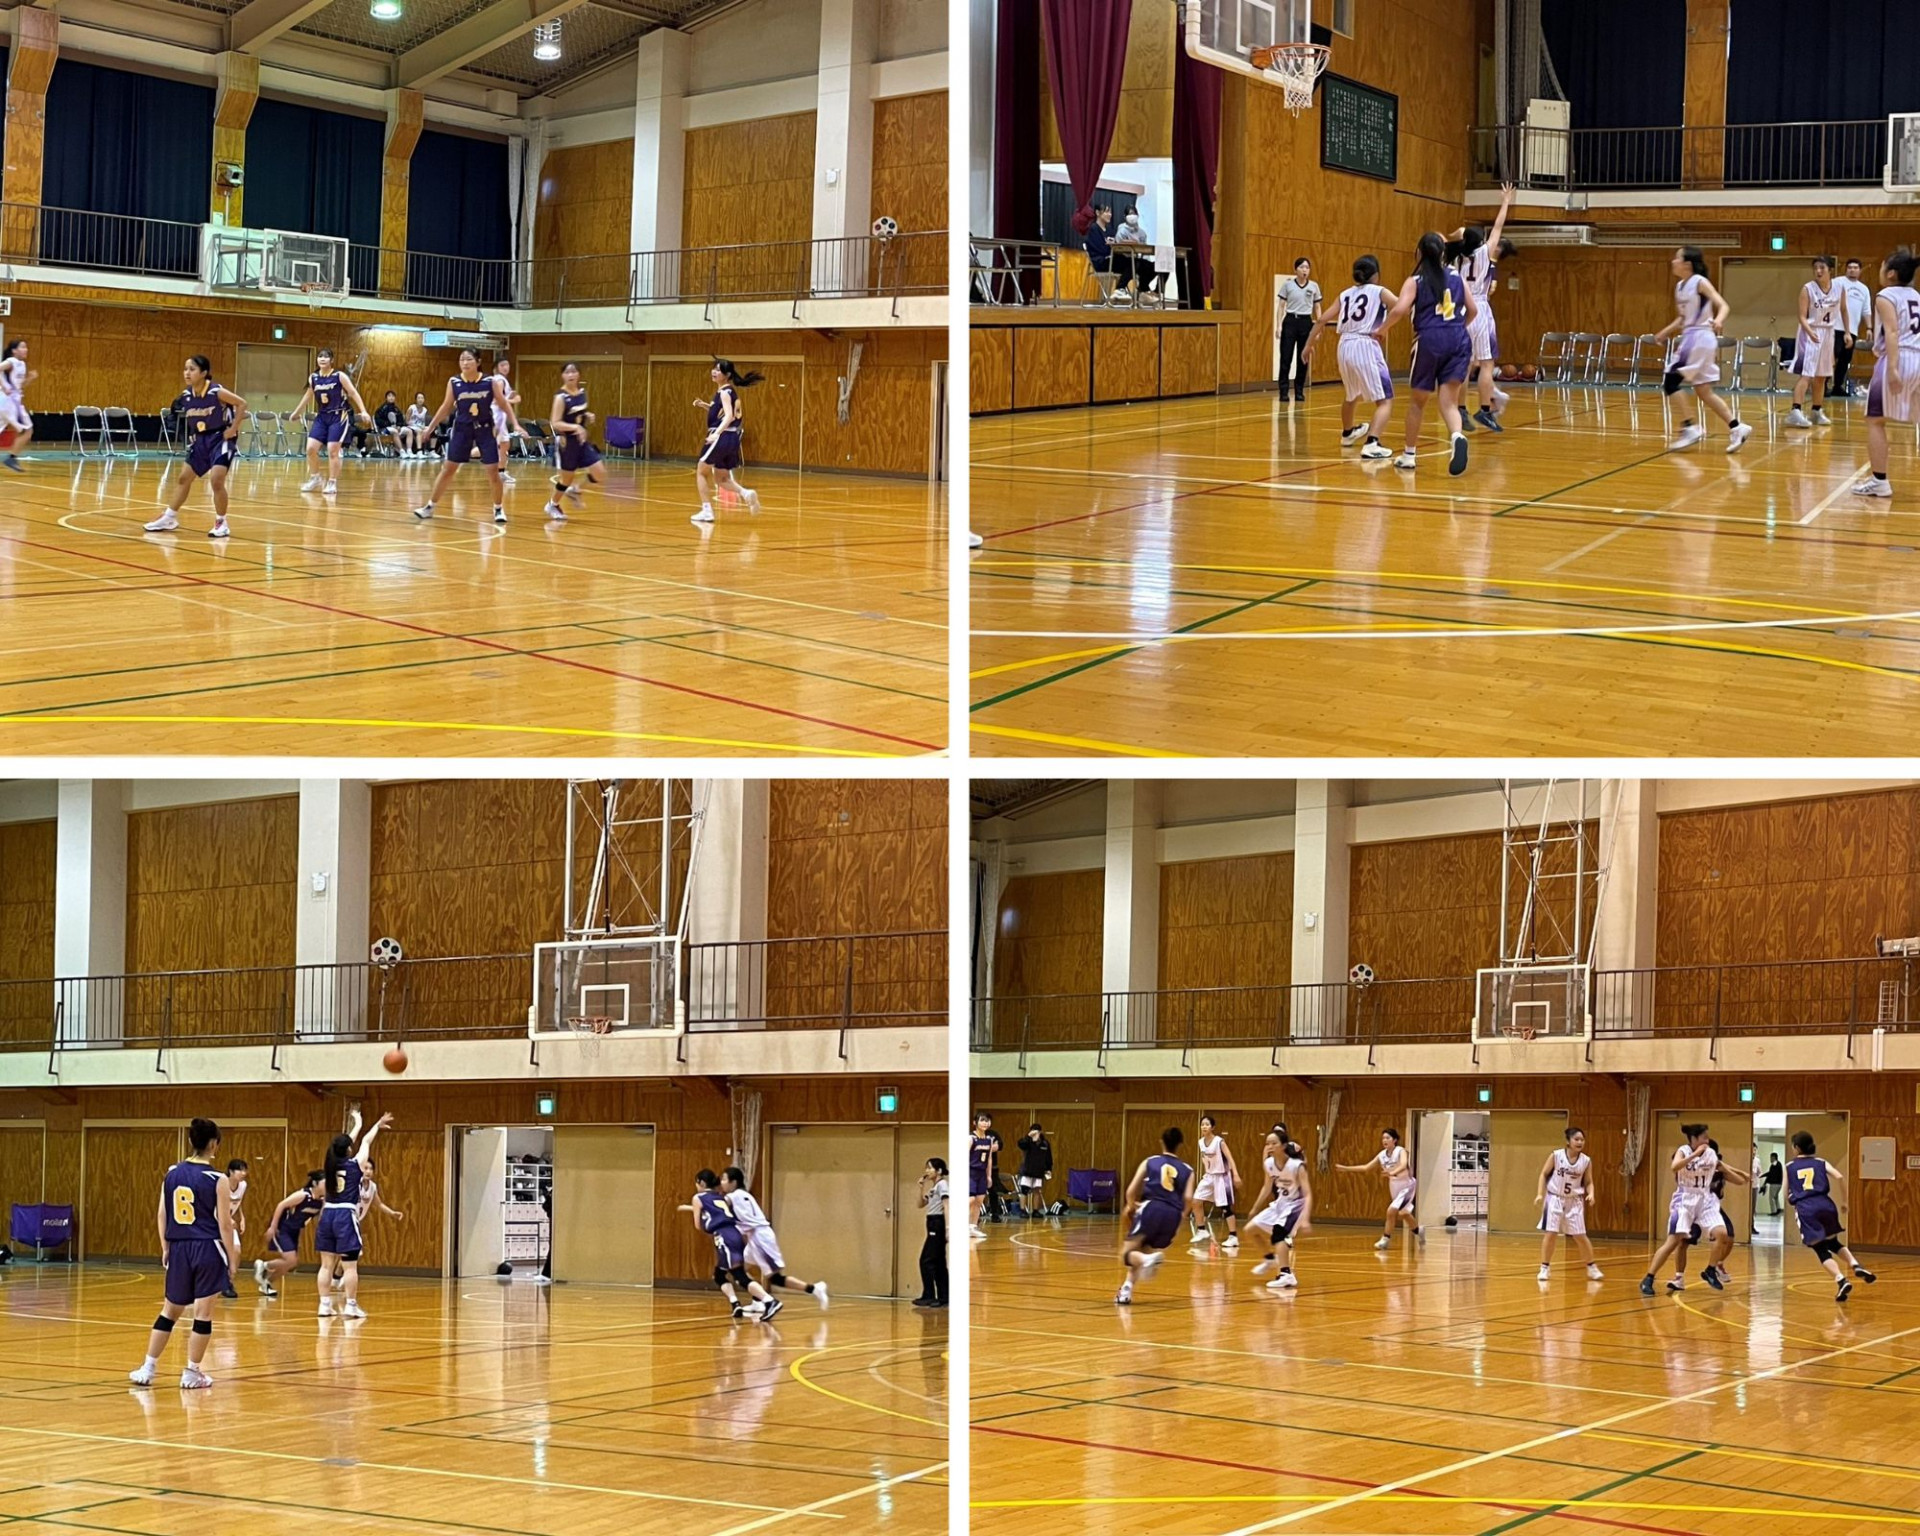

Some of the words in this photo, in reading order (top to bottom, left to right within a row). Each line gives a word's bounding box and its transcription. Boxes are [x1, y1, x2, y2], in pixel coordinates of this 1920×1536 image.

[1341, 294, 1368, 324] 13
[1435, 288, 1455, 321] 4
[1823, 312, 1830, 323] 4
[469, 403, 478, 416] 4
[1694, 1175, 1706, 1188] 11
[1797, 1167, 1815, 1191] 7
[1564, 1183, 1572, 1194] 5
[173, 1186, 196, 1225] 6
